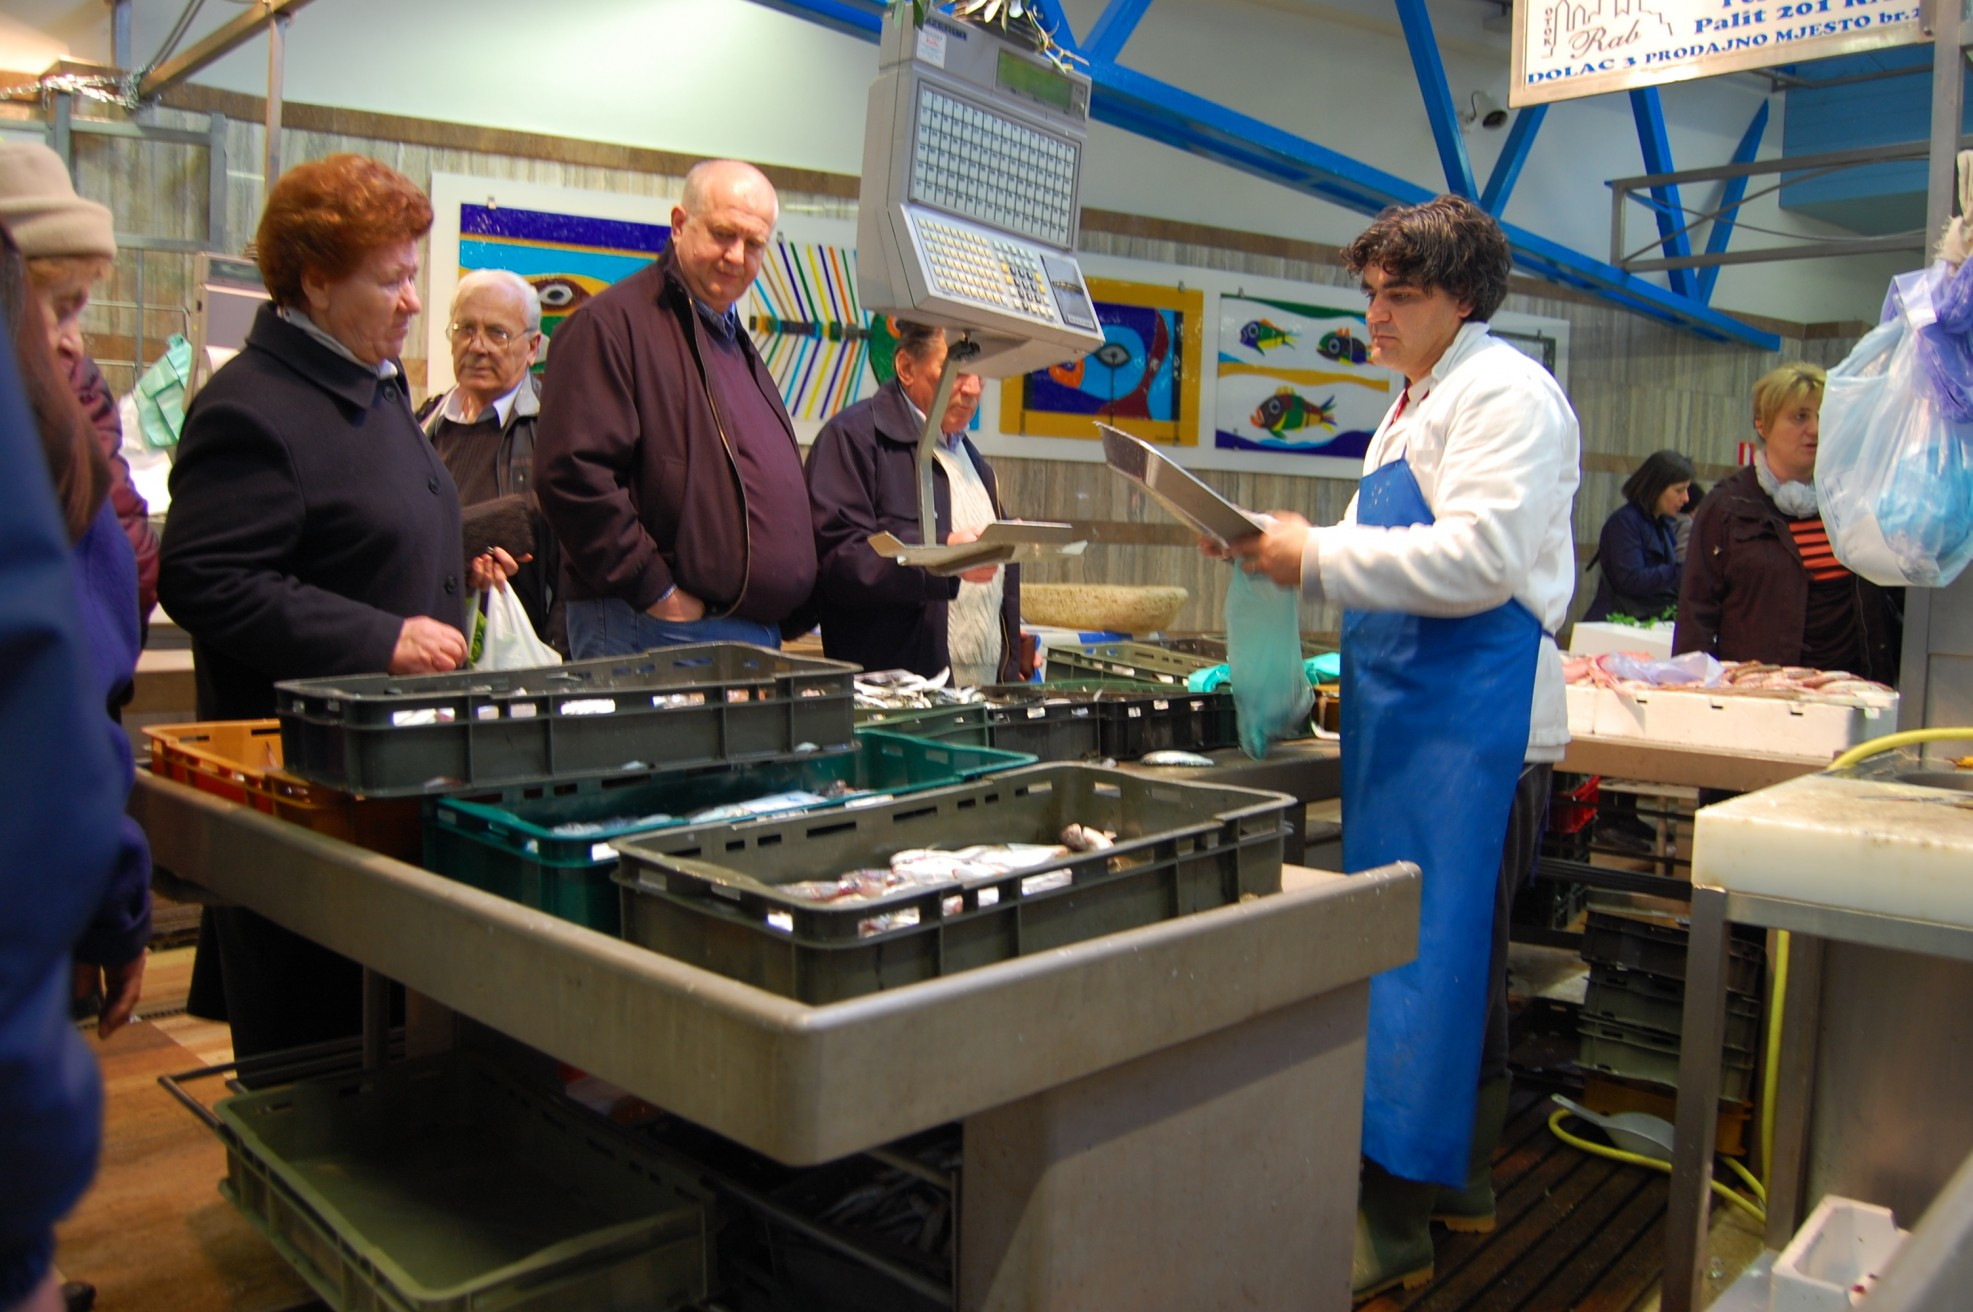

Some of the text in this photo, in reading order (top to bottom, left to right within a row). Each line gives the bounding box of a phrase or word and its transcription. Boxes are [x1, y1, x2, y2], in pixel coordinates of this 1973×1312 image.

[1543, 7, 1553, 47] OTOK
[1694, 0, 1832, 35] Palit 201
[1527, 58, 1615, 84] DOLAC
[1645, 33, 1768, 63] PRODAJNO
[1775, 15, 1871, 43] MJESTO
[1567, 18, 1641, 59] Rab
